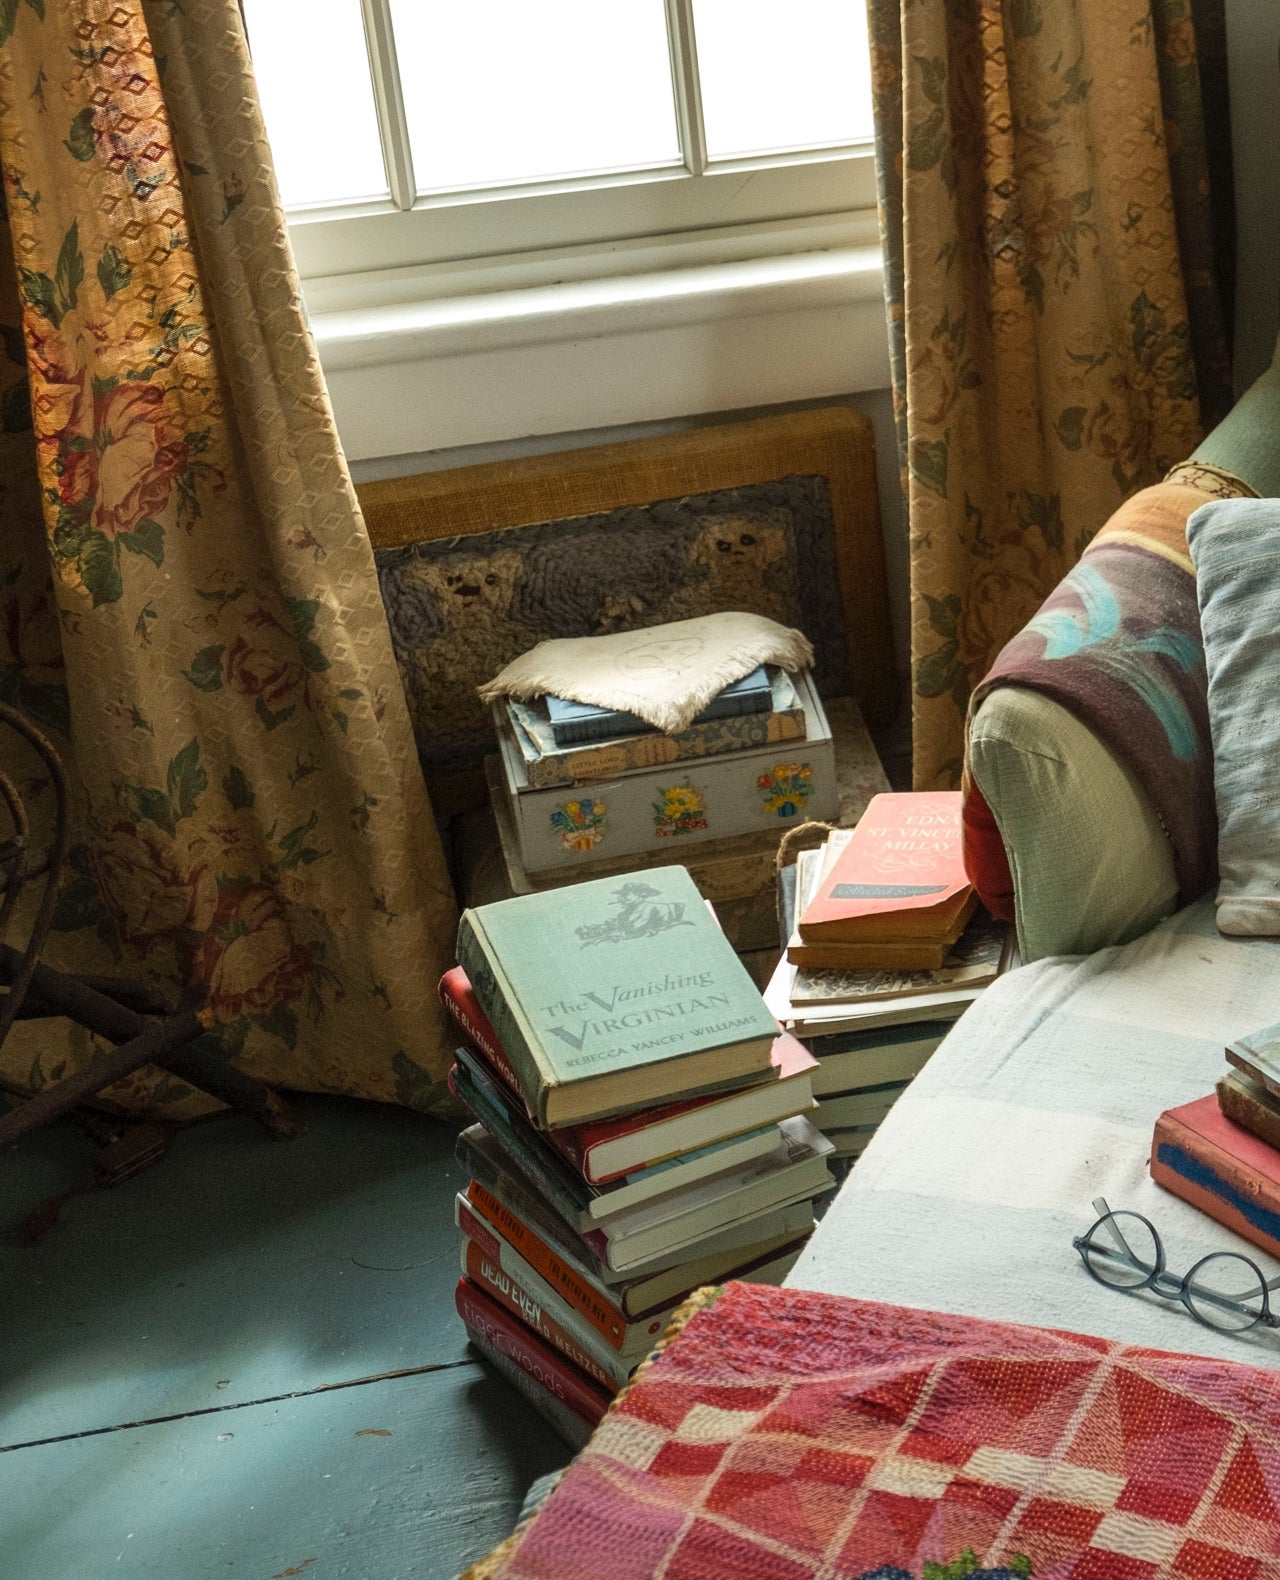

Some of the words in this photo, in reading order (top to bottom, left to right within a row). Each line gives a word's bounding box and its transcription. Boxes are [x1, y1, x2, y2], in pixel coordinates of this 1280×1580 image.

[867, 828, 893, 838] ST.
[900, 828, 962, 838] VINCE
[881, 841, 955, 851] MILLAY
[905, 815, 962, 825] EDNA
[541, 1001, 588, 1018] The
[581, 971, 715, 1013] Vanishing
[443, 992, 461, 1020] THE
[461, 1014, 497, 1062] BLAZING
[545, 992, 731, 1052] VIRGINIAN
[566, 1049, 628, 1068] REBECCA
[632, 1032, 686, 1052] YANCEY
[690, 1015, 759, 1037] WILLIAMS
[480, 1259, 510, 1296] DEAD
[511, 1286, 542, 1324] EVEN
[548, 1257, 562, 1279] THE
[463, 1298, 505, 1351] tiger
[508, 1346, 566, 1400] woods
[523, 1311, 551, 1338] BRAD
[555, 1335, 607, 1382] MELTZER
